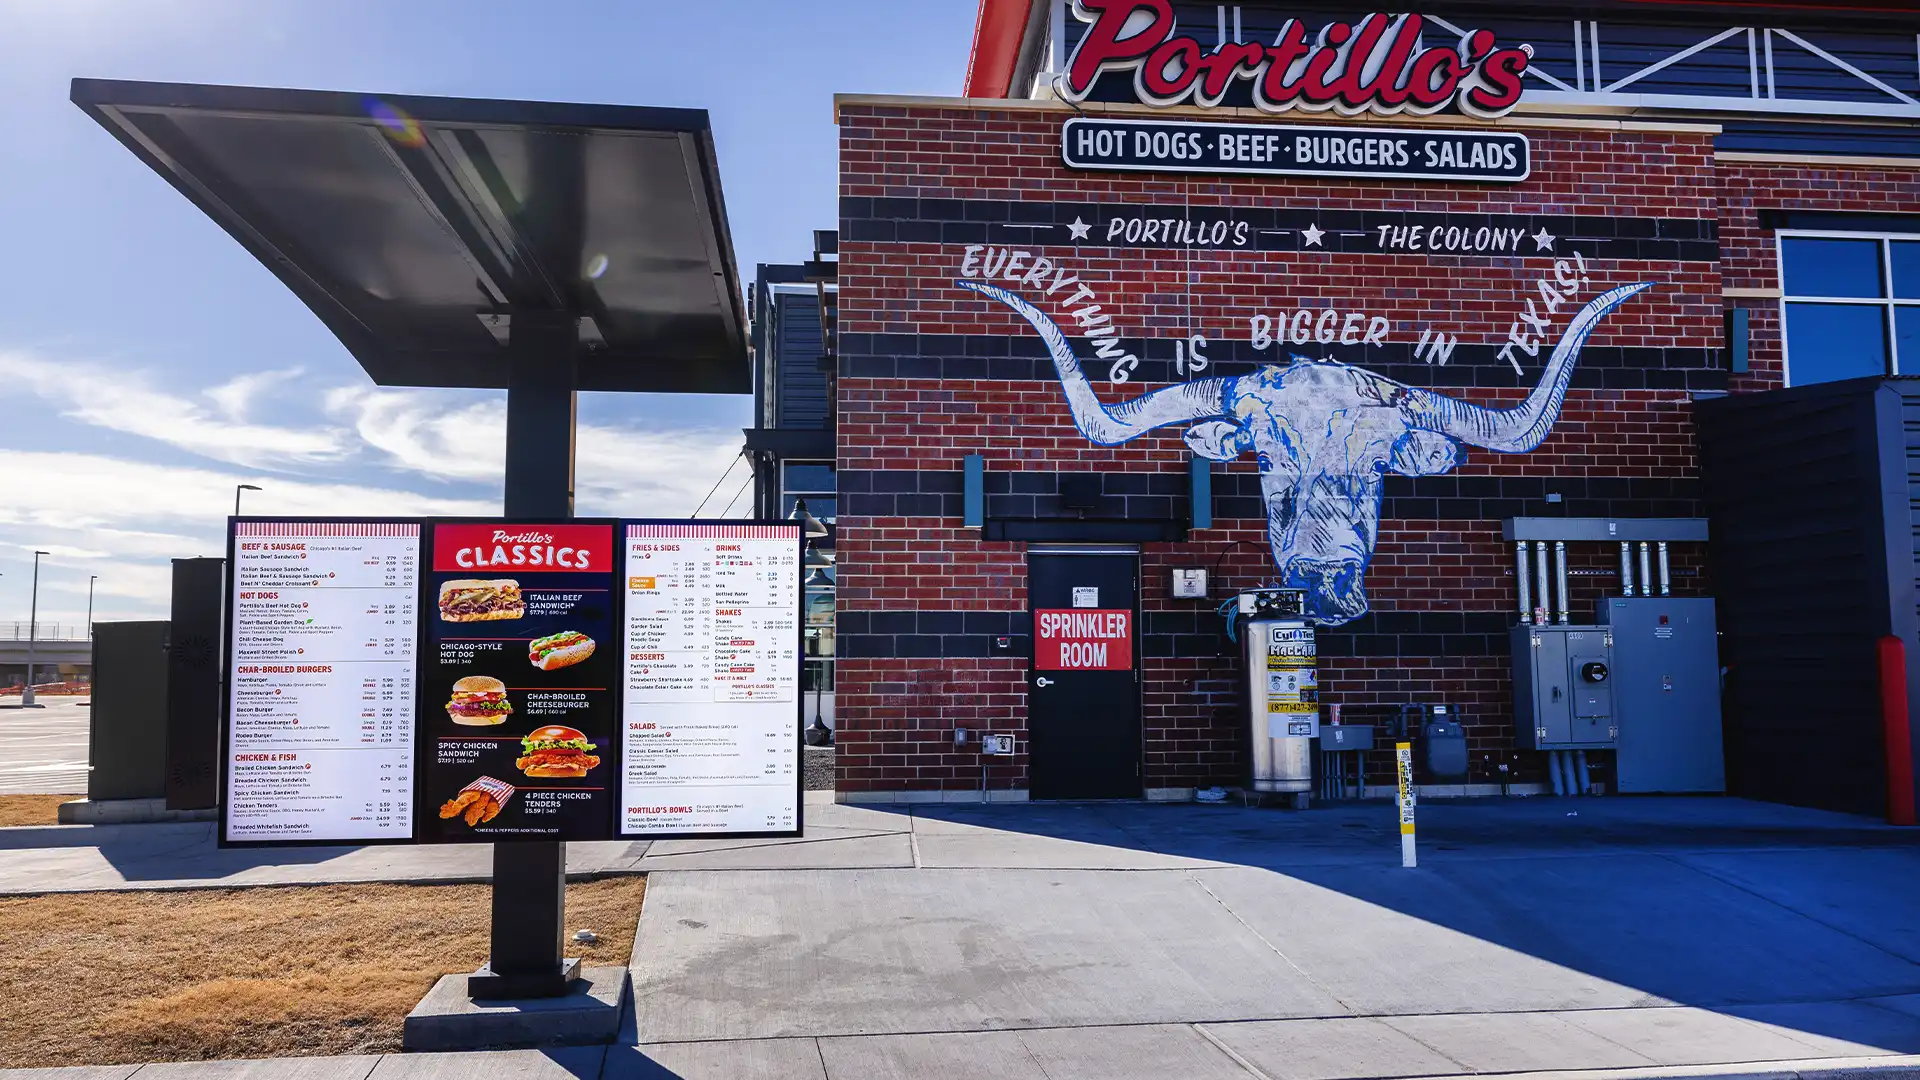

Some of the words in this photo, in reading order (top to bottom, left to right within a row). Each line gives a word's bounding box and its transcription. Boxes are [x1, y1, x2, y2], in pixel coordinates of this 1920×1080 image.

[1061, 0, 1530, 118] Portillo's
[1077, 130, 1126, 157] HOT
[1135, 132, 1201, 160] DOGS
[1219, 134, 1279, 163] BEEF
[1296, 137, 1409, 166] BURGERS
[1425, 140, 1516, 170] SALADS
[1106, 217, 1248, 246] PORTILLO'S
[1377, 225, 1423, 249] THE
[1428, 226, 1525, 251] COLONY
[1175, 334, 1208, 376] IS
[1250, 309, 1390, 350] BIGGER
[1413, 329, 1457, 367] IN
[1496, 251, 1590, 376] TEXAS!
[492, 530, 553, 544] Portillo's
[456, 545, 590, 569] CLASSICS
[1040, 613, 1127, 639] SPRINKLER
[1060, 642, 1107, 667] ROOM
